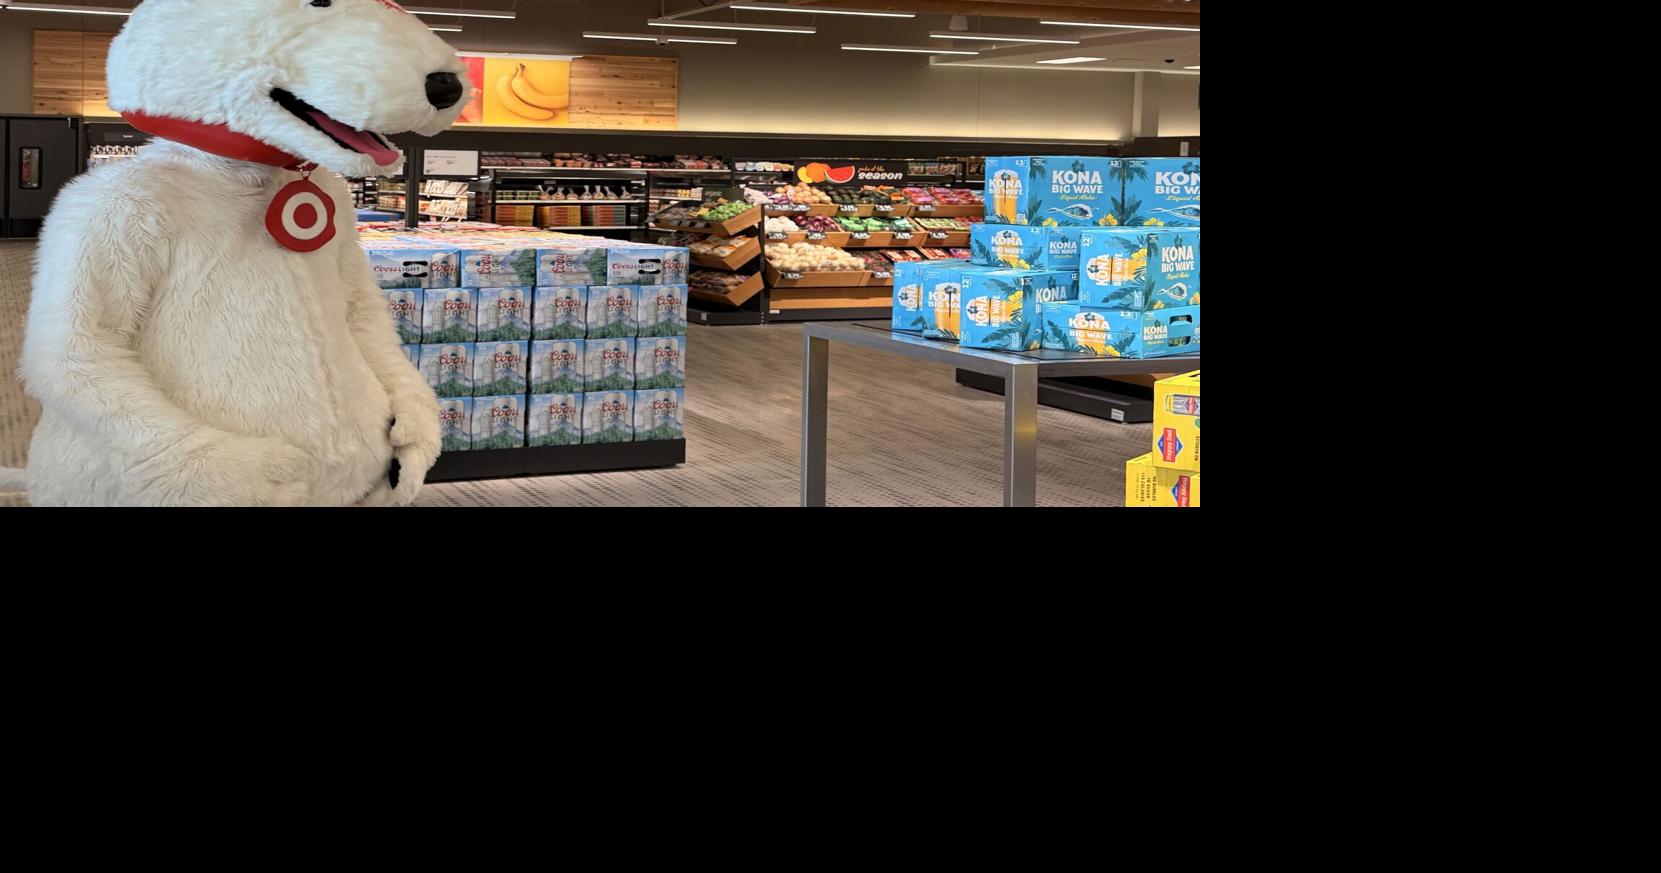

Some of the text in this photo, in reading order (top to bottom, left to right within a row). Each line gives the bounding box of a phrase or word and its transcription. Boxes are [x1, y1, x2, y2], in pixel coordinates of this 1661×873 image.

[858, 172, 903, 180] season
[1052, 170, 1102, 185] KONA
[988, 179, 1022, 188] KONA
[1052, 184, 1104, 194] BIG WAVE
[1155, 186, 1200, 194] BIG W
[991, 236, 1022, 246] KONA
[1050, 241, 1077, 249] KONA
[1162, 246, 1194, 262] KONA
[1096, 254, 1110, 286] KONA
[1162, 261, 1194, 272] BIG WAVE
[1036, 286, 1067, 303] KONA
[976, 296, 988, 326] KONA
[1068, 318, 1110, 330] KONA
[1070, 330, 1112, 340] BIG WAVE
[1144, 326, 1168, 334] KONA
